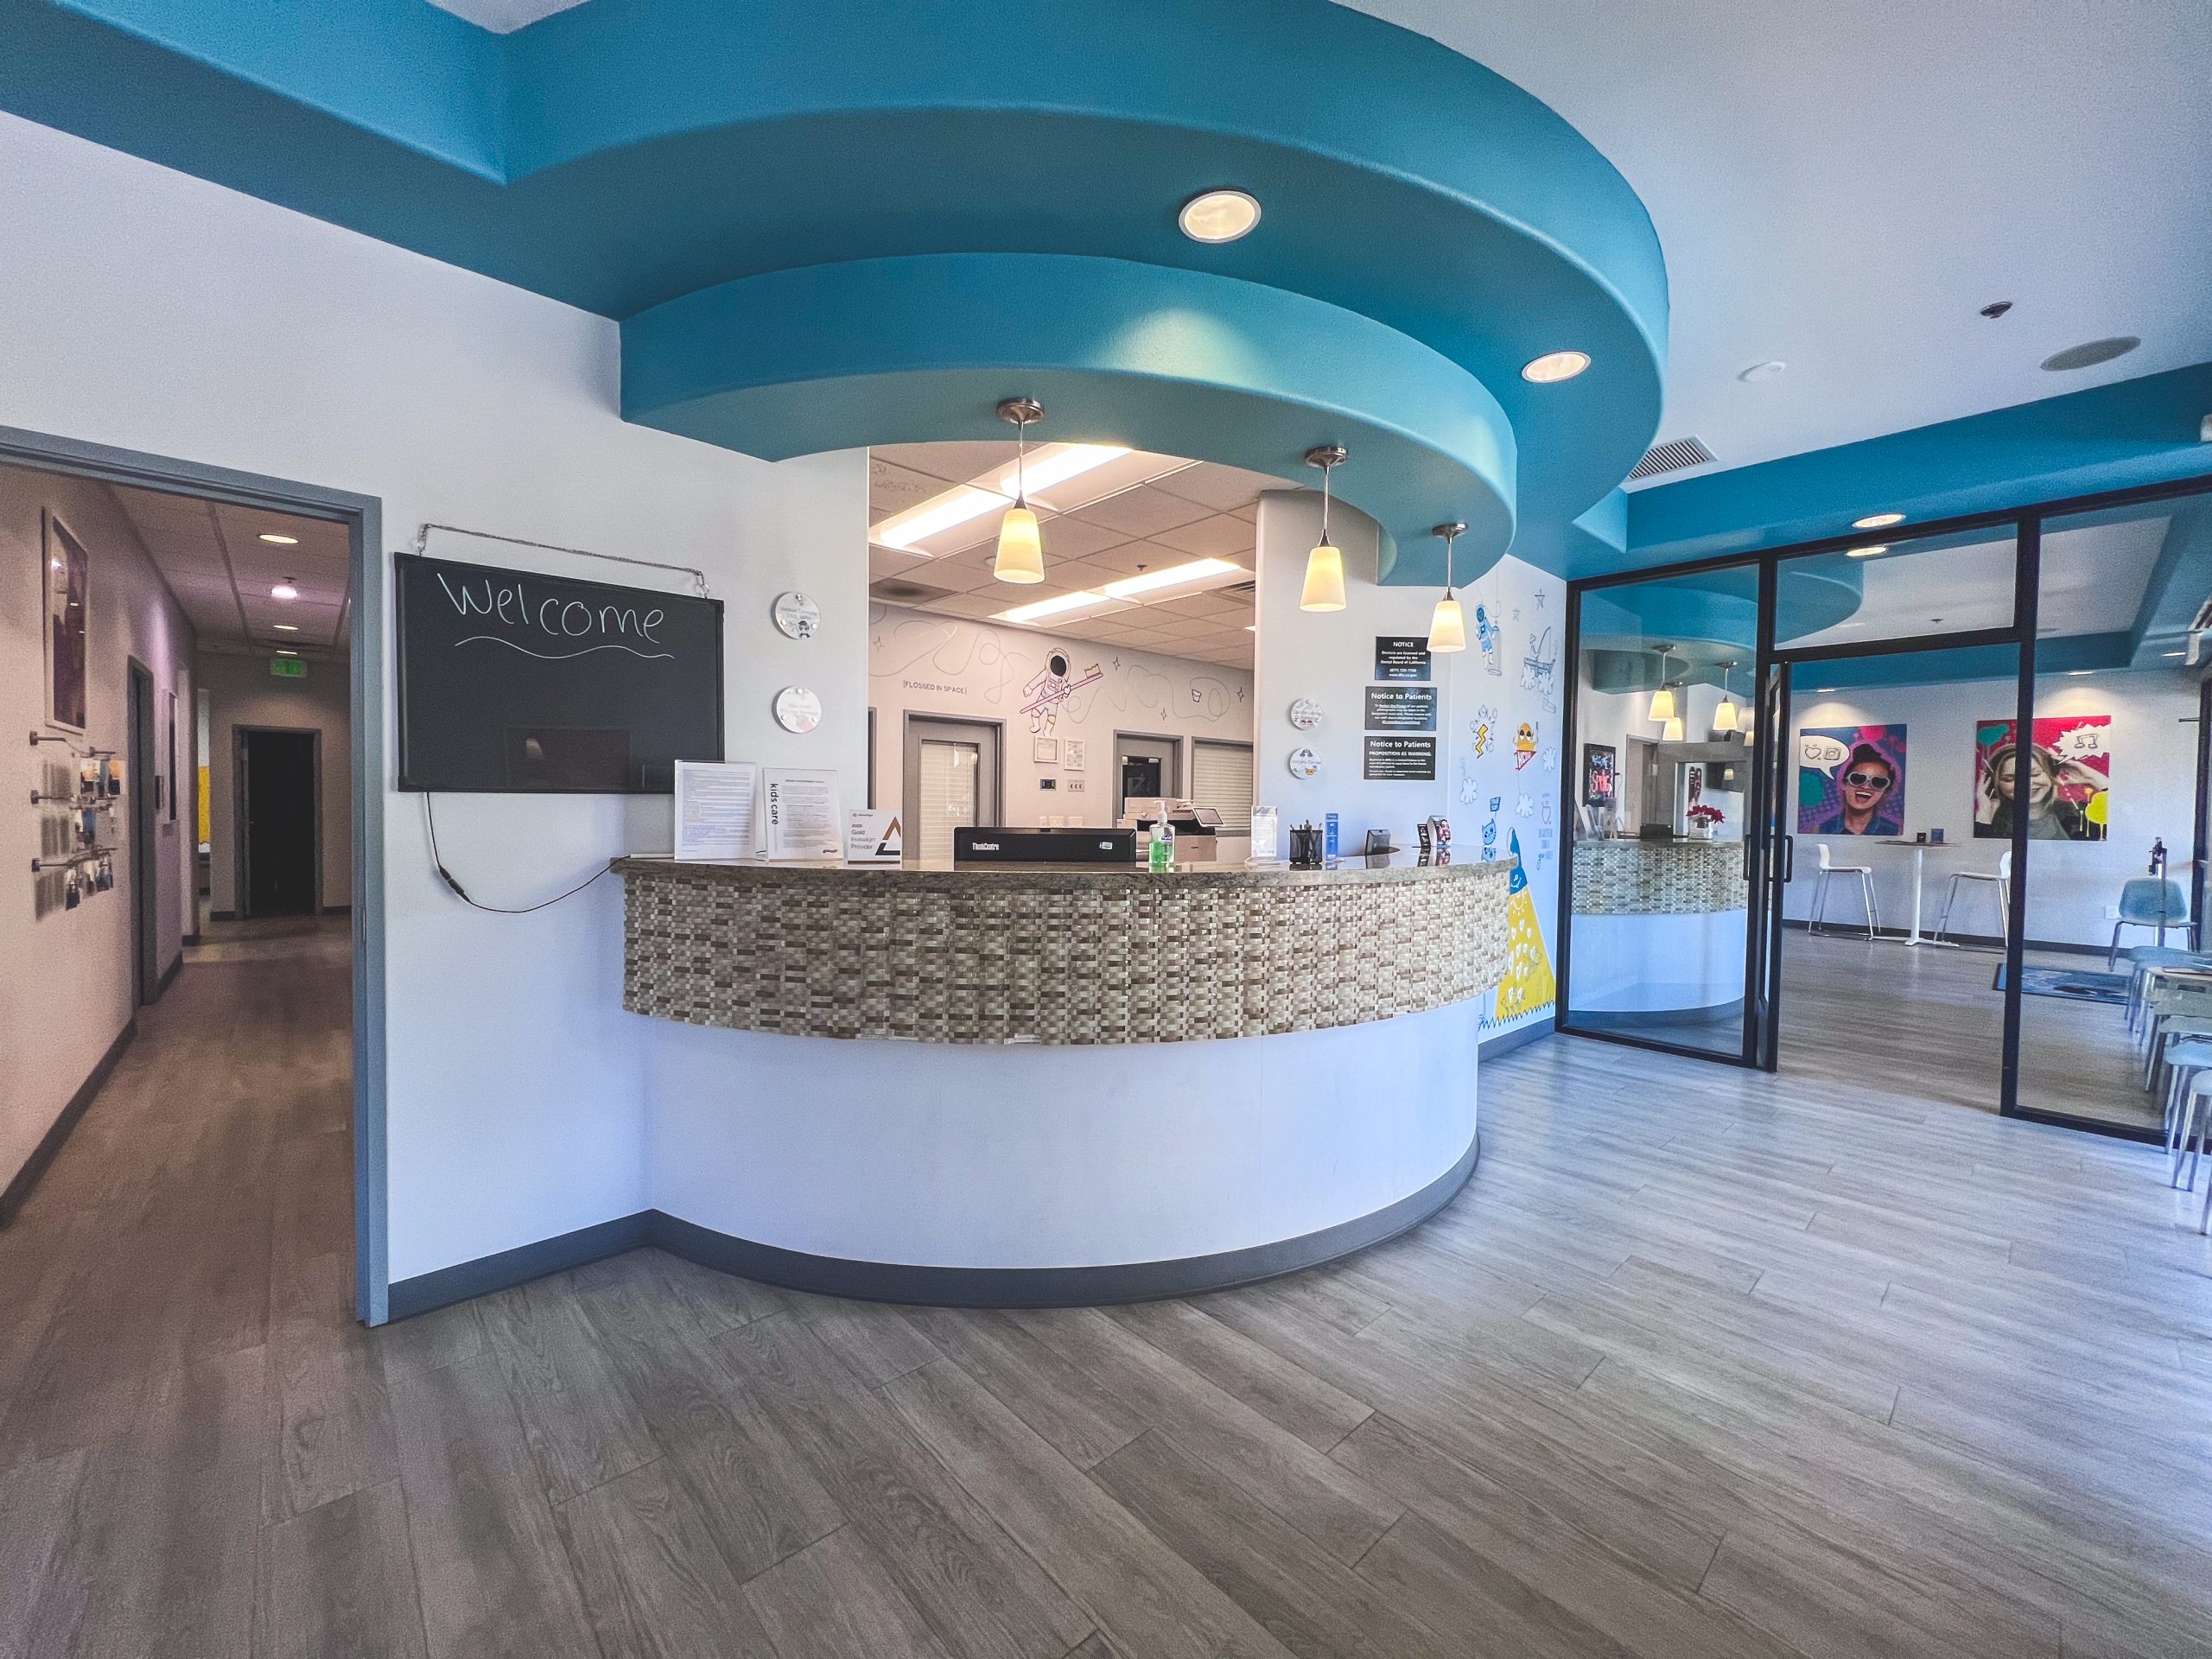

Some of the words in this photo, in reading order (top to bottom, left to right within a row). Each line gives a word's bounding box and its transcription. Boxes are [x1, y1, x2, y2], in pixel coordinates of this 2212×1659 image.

[436, 573, 664, 645] Welcome
[769, 783, 779, 803] kids
[771, 804, 779, 825] care
